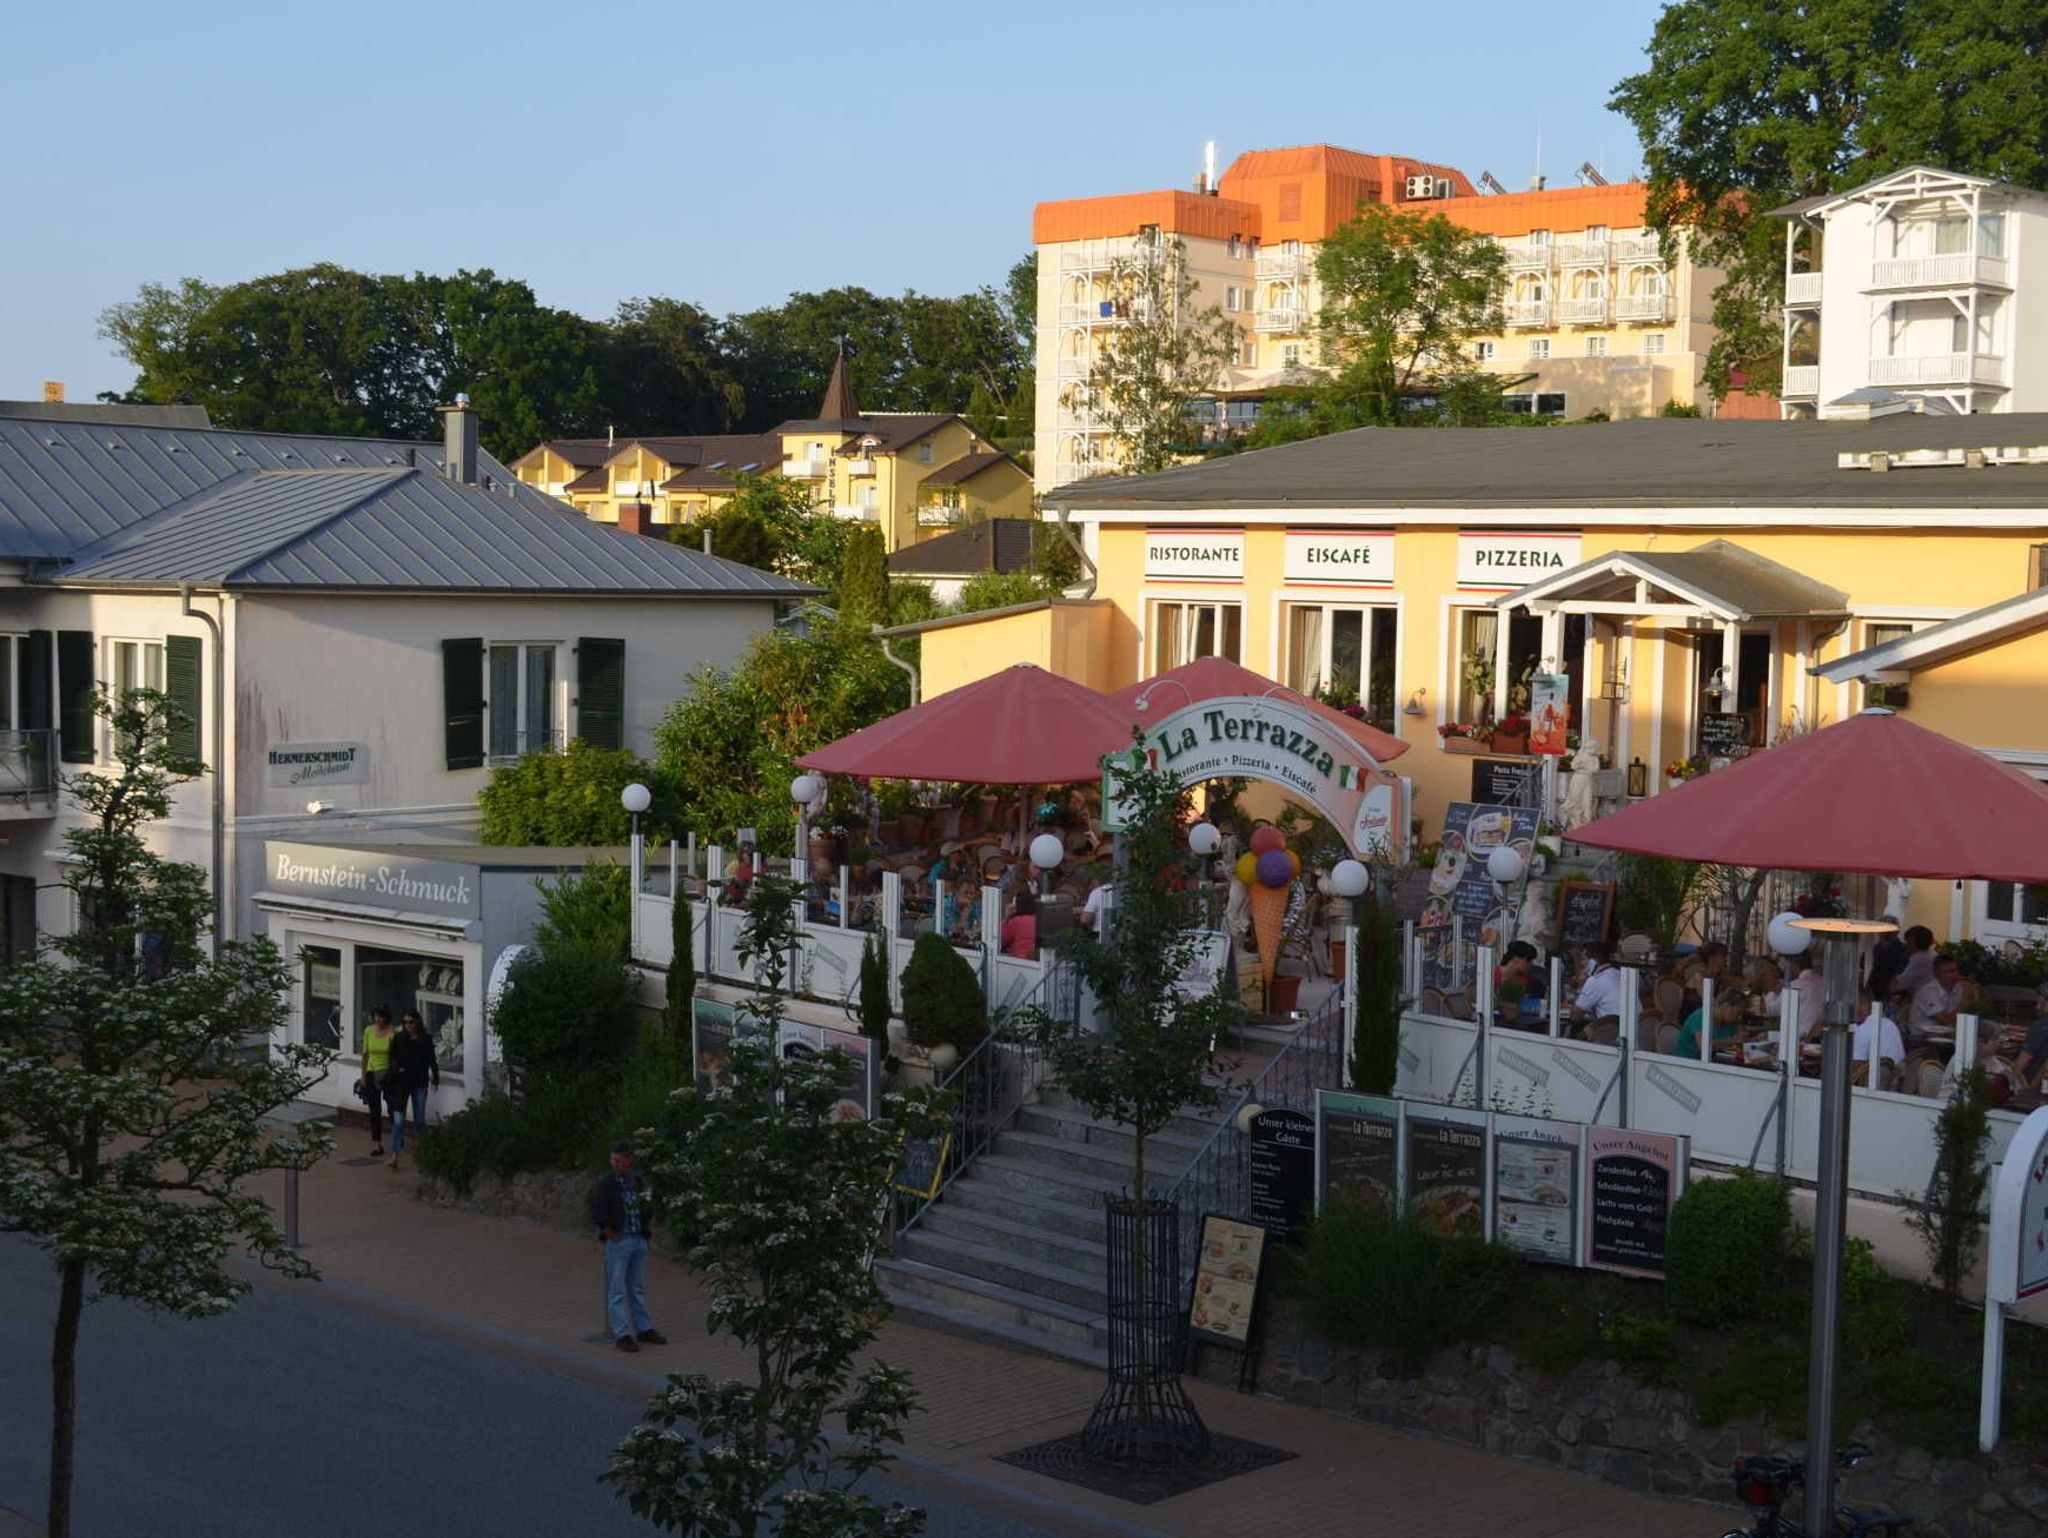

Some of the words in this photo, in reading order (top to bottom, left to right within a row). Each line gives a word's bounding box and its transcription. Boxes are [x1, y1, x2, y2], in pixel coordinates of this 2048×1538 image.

[1149, 545, 1240, 562] RISTORANTE
[1306, 545, 1372, 565] EISCAFÉ
[1475, 549, 1564, 568] PIZZERIA
[1157, 726, 1198, 763] La
[1204, 709, 1335, 778] Terrazza
[268, 747, 356, 765] HERMERSCHMIDT
[1173, 757, 1221, 779] istorante
[1231, 754, 1272, 771] Pizzeria
[276, 854, 471, 905] Bernstein-Schmuck
[1592, 1140, 1623, 1152] Unser
